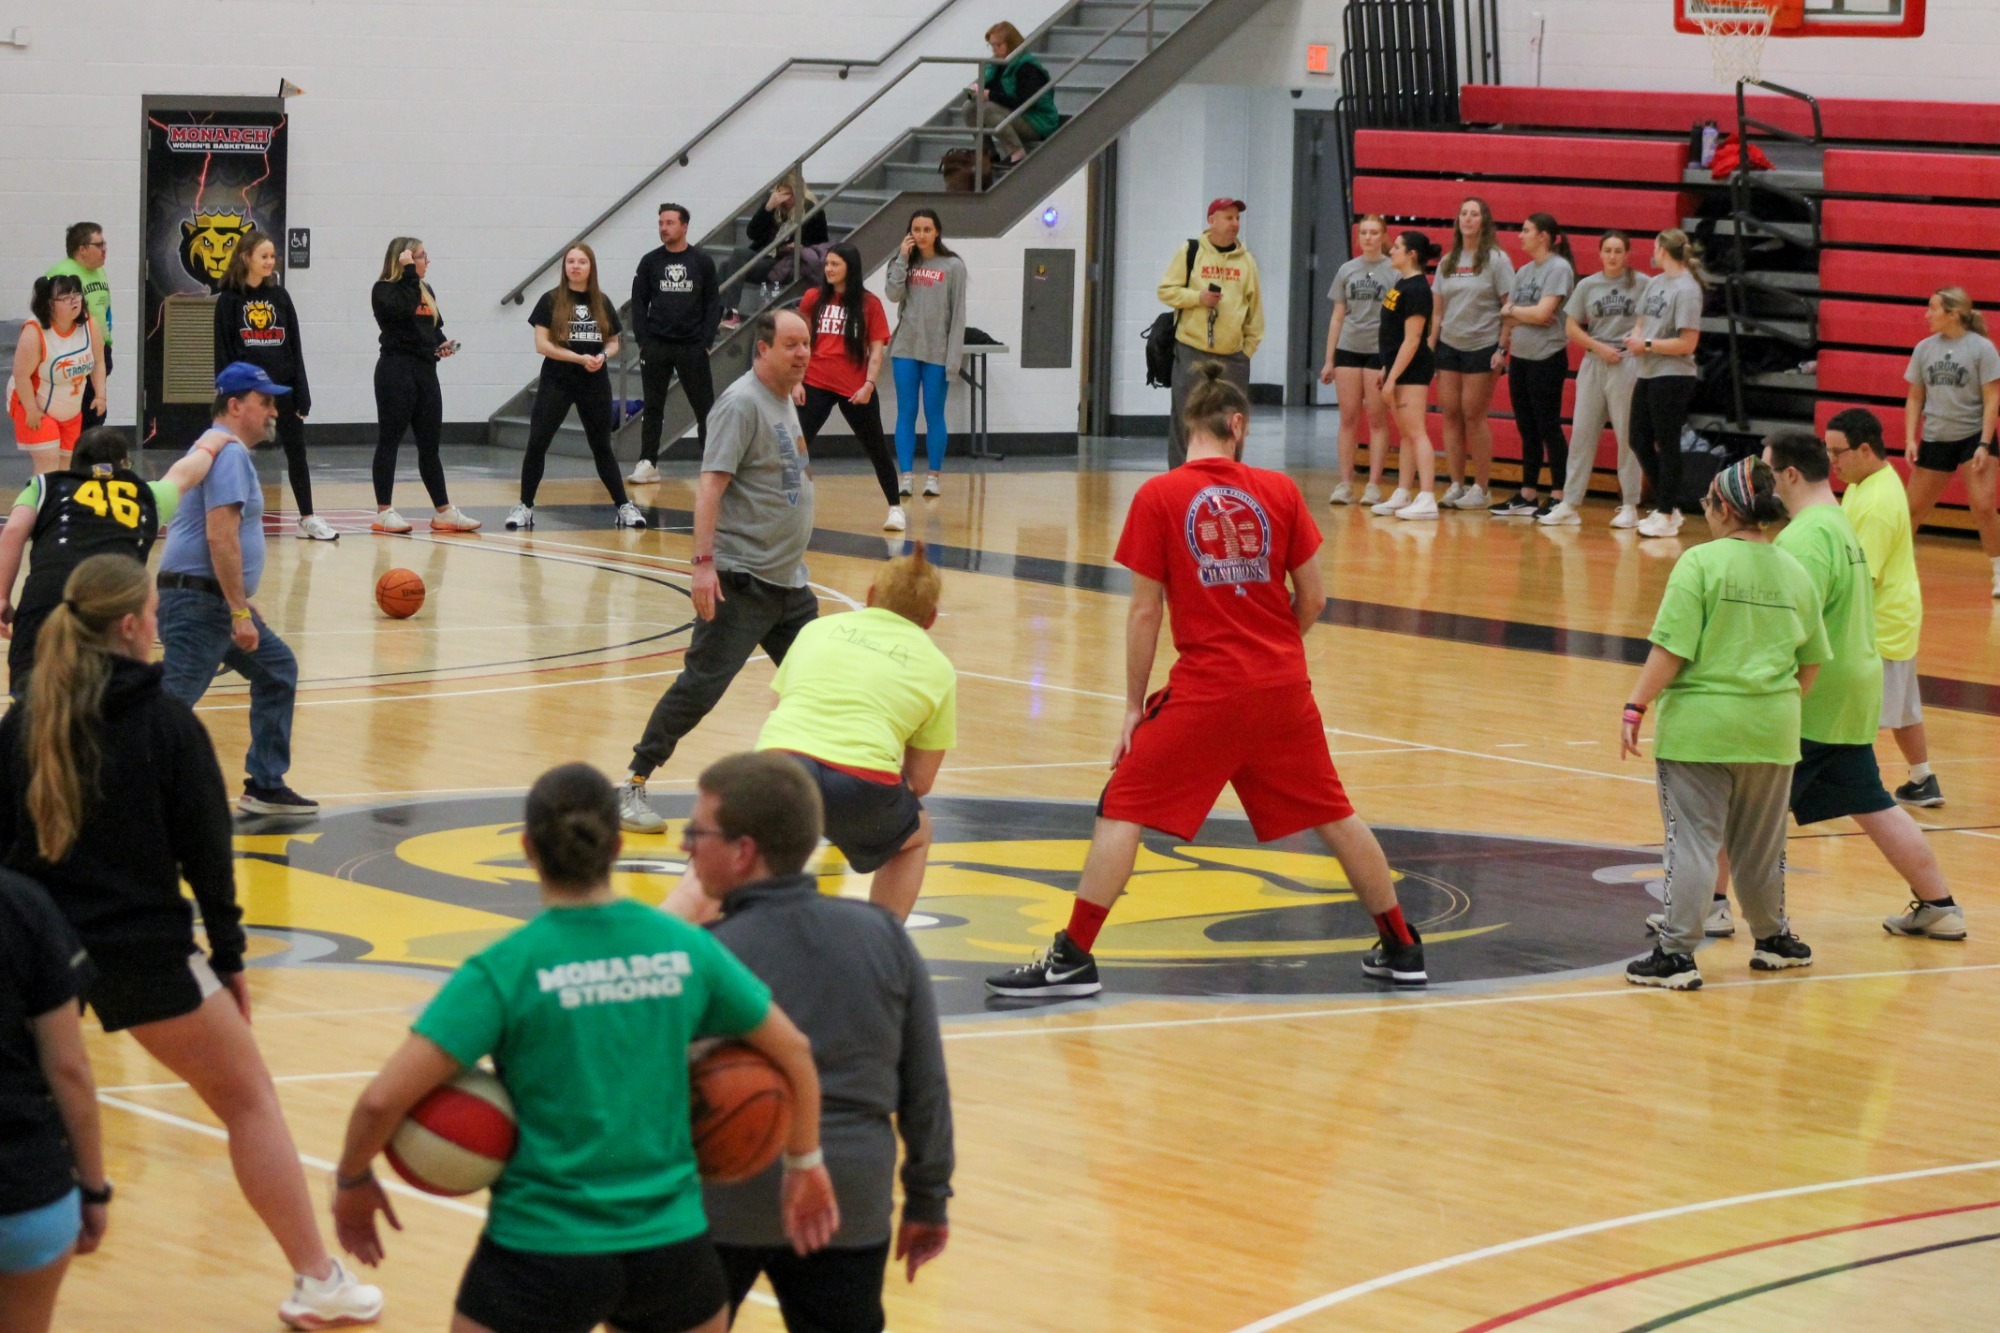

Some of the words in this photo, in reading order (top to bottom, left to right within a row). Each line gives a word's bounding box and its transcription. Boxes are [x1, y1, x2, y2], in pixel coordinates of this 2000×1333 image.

[171, 127, 269, 143] MONARCH
[213, 142, 265, 150] BASKETBALL
[1356, 280, 1379, 290] IRON
[1602, 295, 1626, 305] IRON
[1934, 361, 1959, 373] IRON
[73, 480, 140, 528] 46
[1199, 565, 1266, 583] CHAMPIONS
[1725, 579, 1781, 600] Heather
[536, 951, 692, 992] MONARCH
[559, 975, 684, 1010] STRONG
